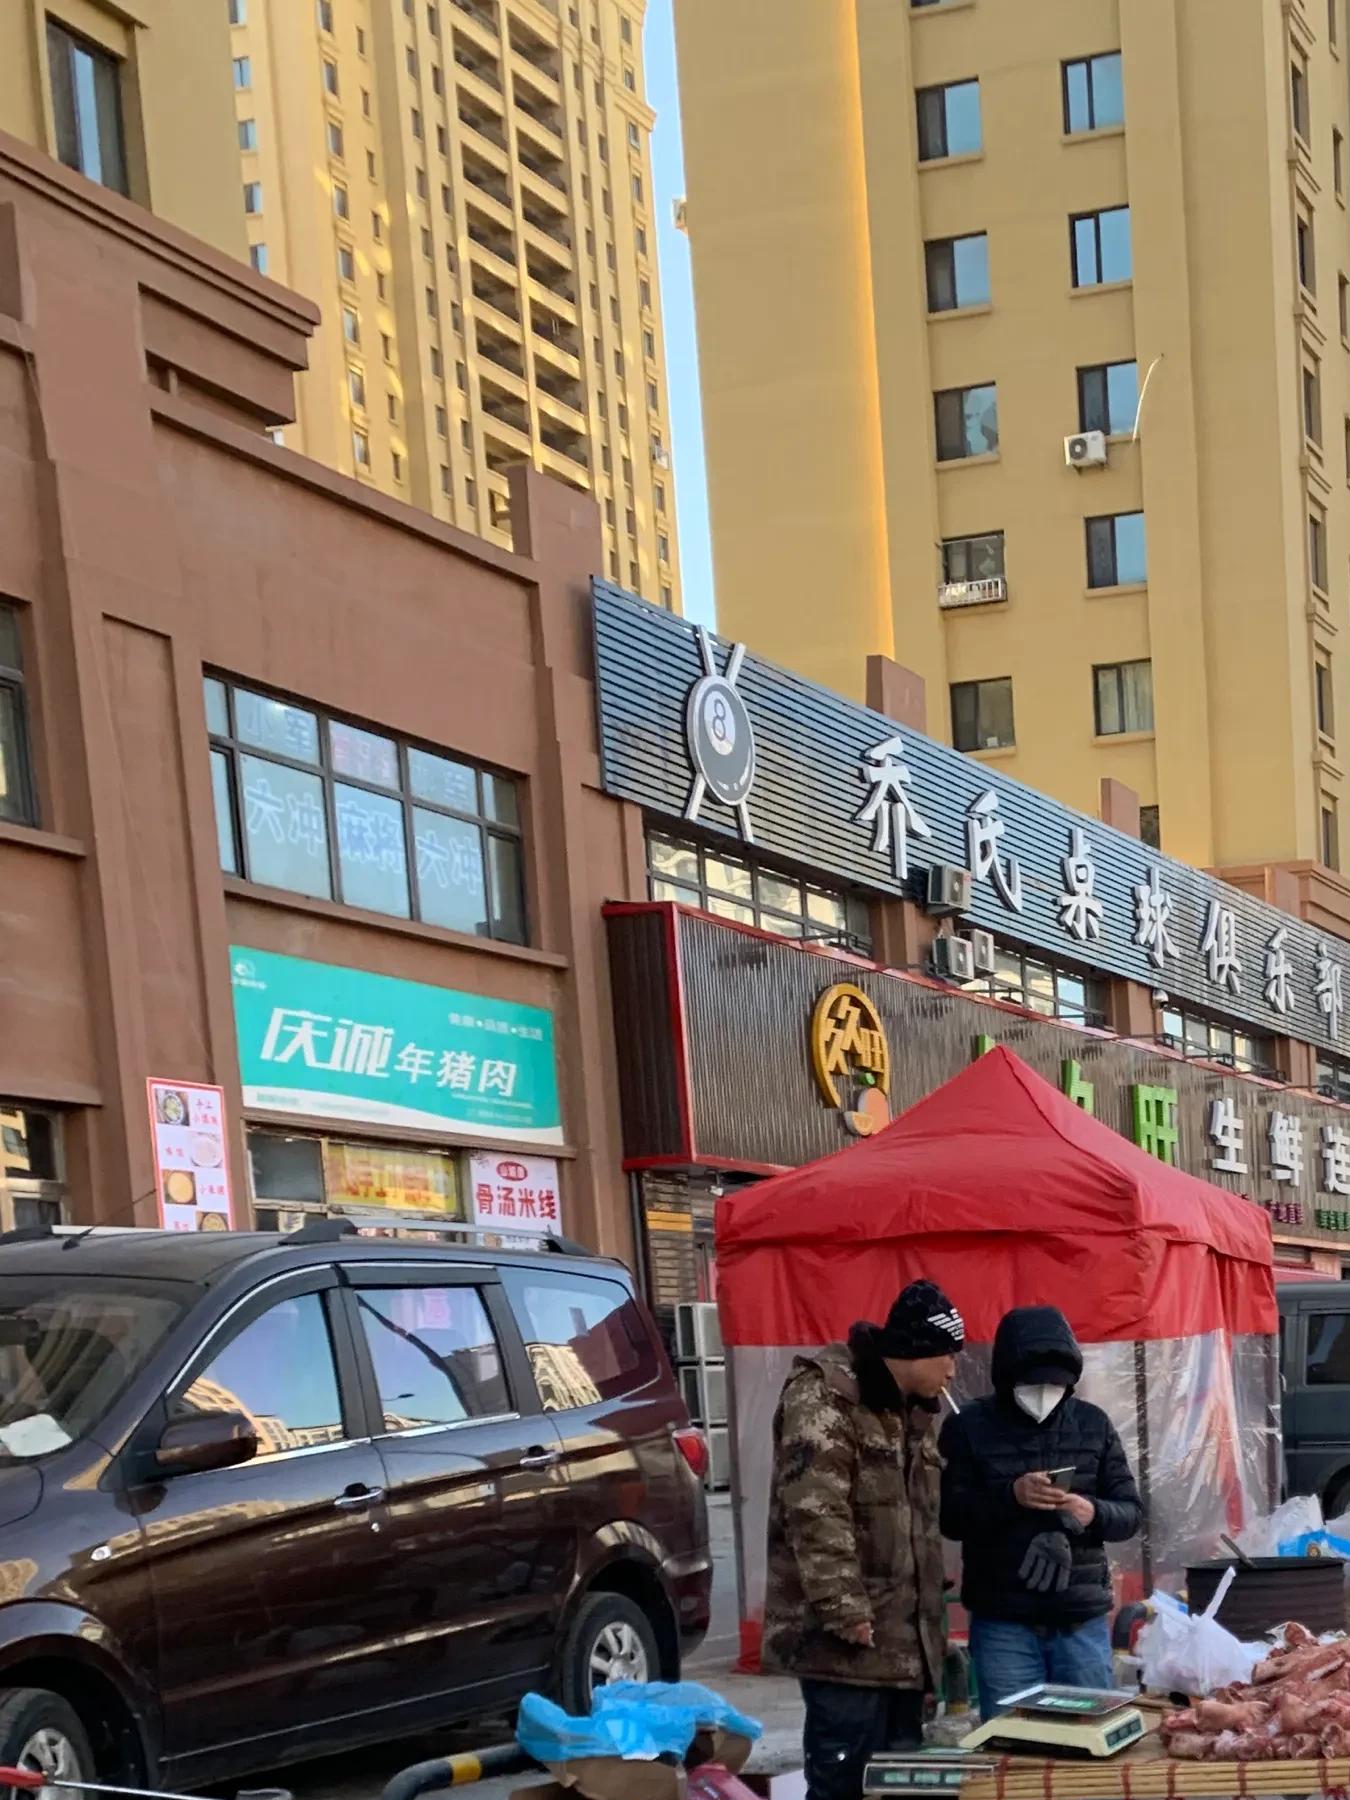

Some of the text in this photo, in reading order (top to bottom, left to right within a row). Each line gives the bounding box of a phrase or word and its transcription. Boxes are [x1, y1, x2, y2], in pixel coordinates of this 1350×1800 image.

[852, 735, 1344, 1041] 乔氏桌球俱乐部
[476, 1183, 557, 1220] 骨汤米线
